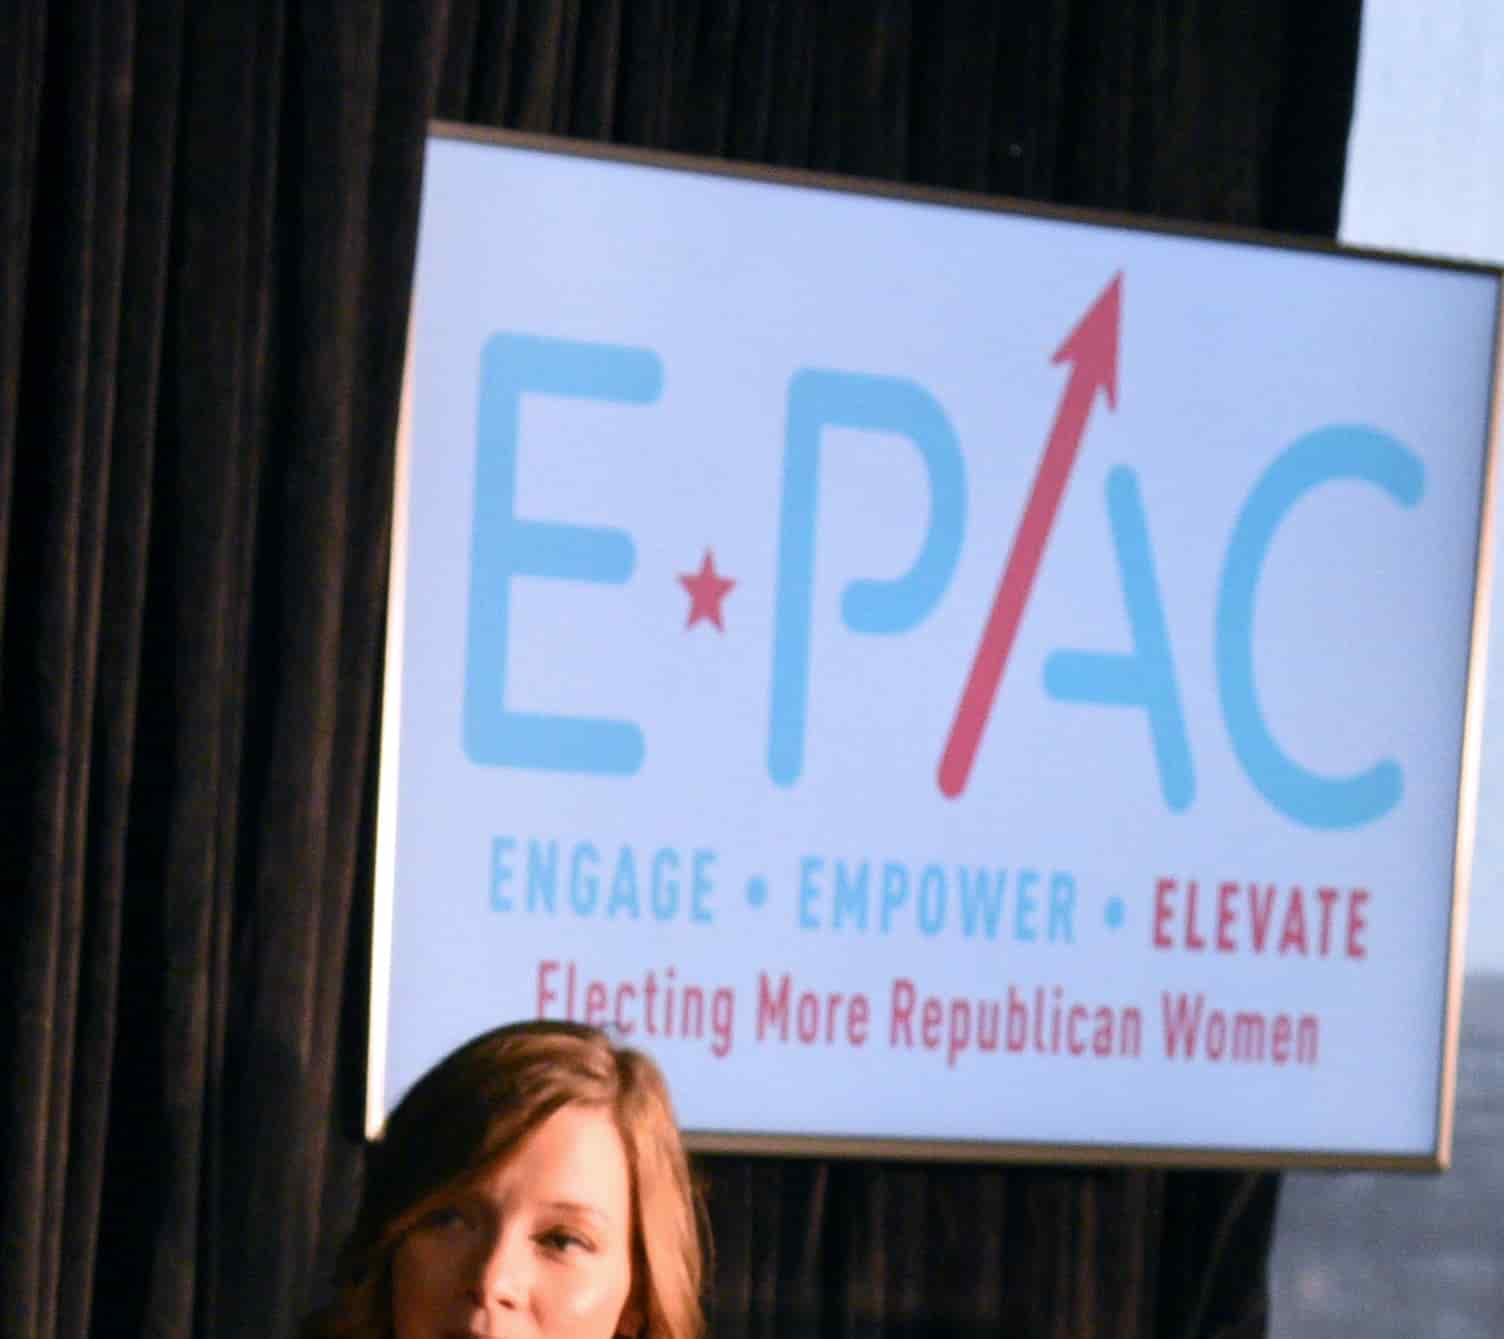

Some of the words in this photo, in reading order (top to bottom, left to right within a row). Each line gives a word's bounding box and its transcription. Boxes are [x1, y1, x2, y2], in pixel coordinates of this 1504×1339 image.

[491, 835, 720, 924] ENGAGE
[798, 854, 1078, 944] EMPOWER
[1152, 877, 1371, 960] ELEVATE
[536, 960, 734, 1058] Electing
[756, 969, 870, 1048] More
[889, 976, 1142, 1069] Republican
[1161, 988, 1320, 1066] Women
